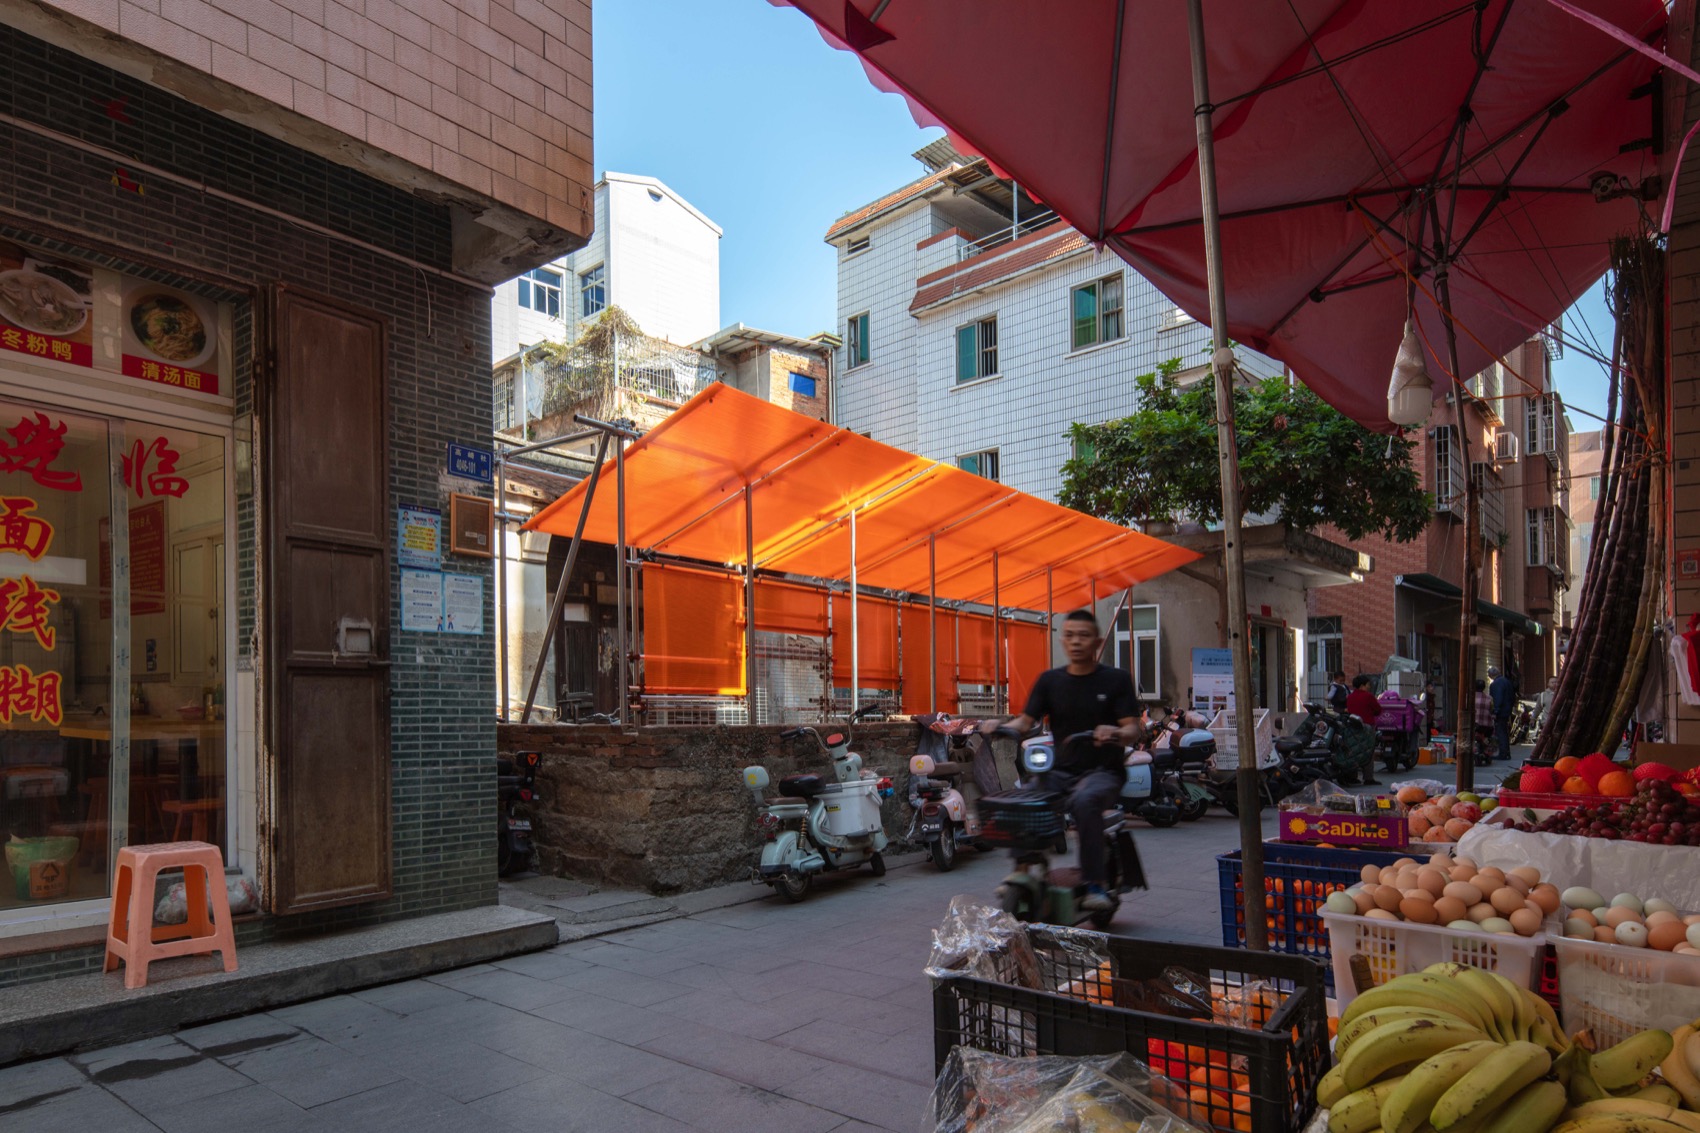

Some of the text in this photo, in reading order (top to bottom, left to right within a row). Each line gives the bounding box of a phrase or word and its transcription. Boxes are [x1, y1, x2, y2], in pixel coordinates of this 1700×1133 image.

[2, 328, 73, 361] 冬粉鸭
[141, 361, 201, 390] 清汤面
[1316, 820, 1389, 839] CaDiMe
